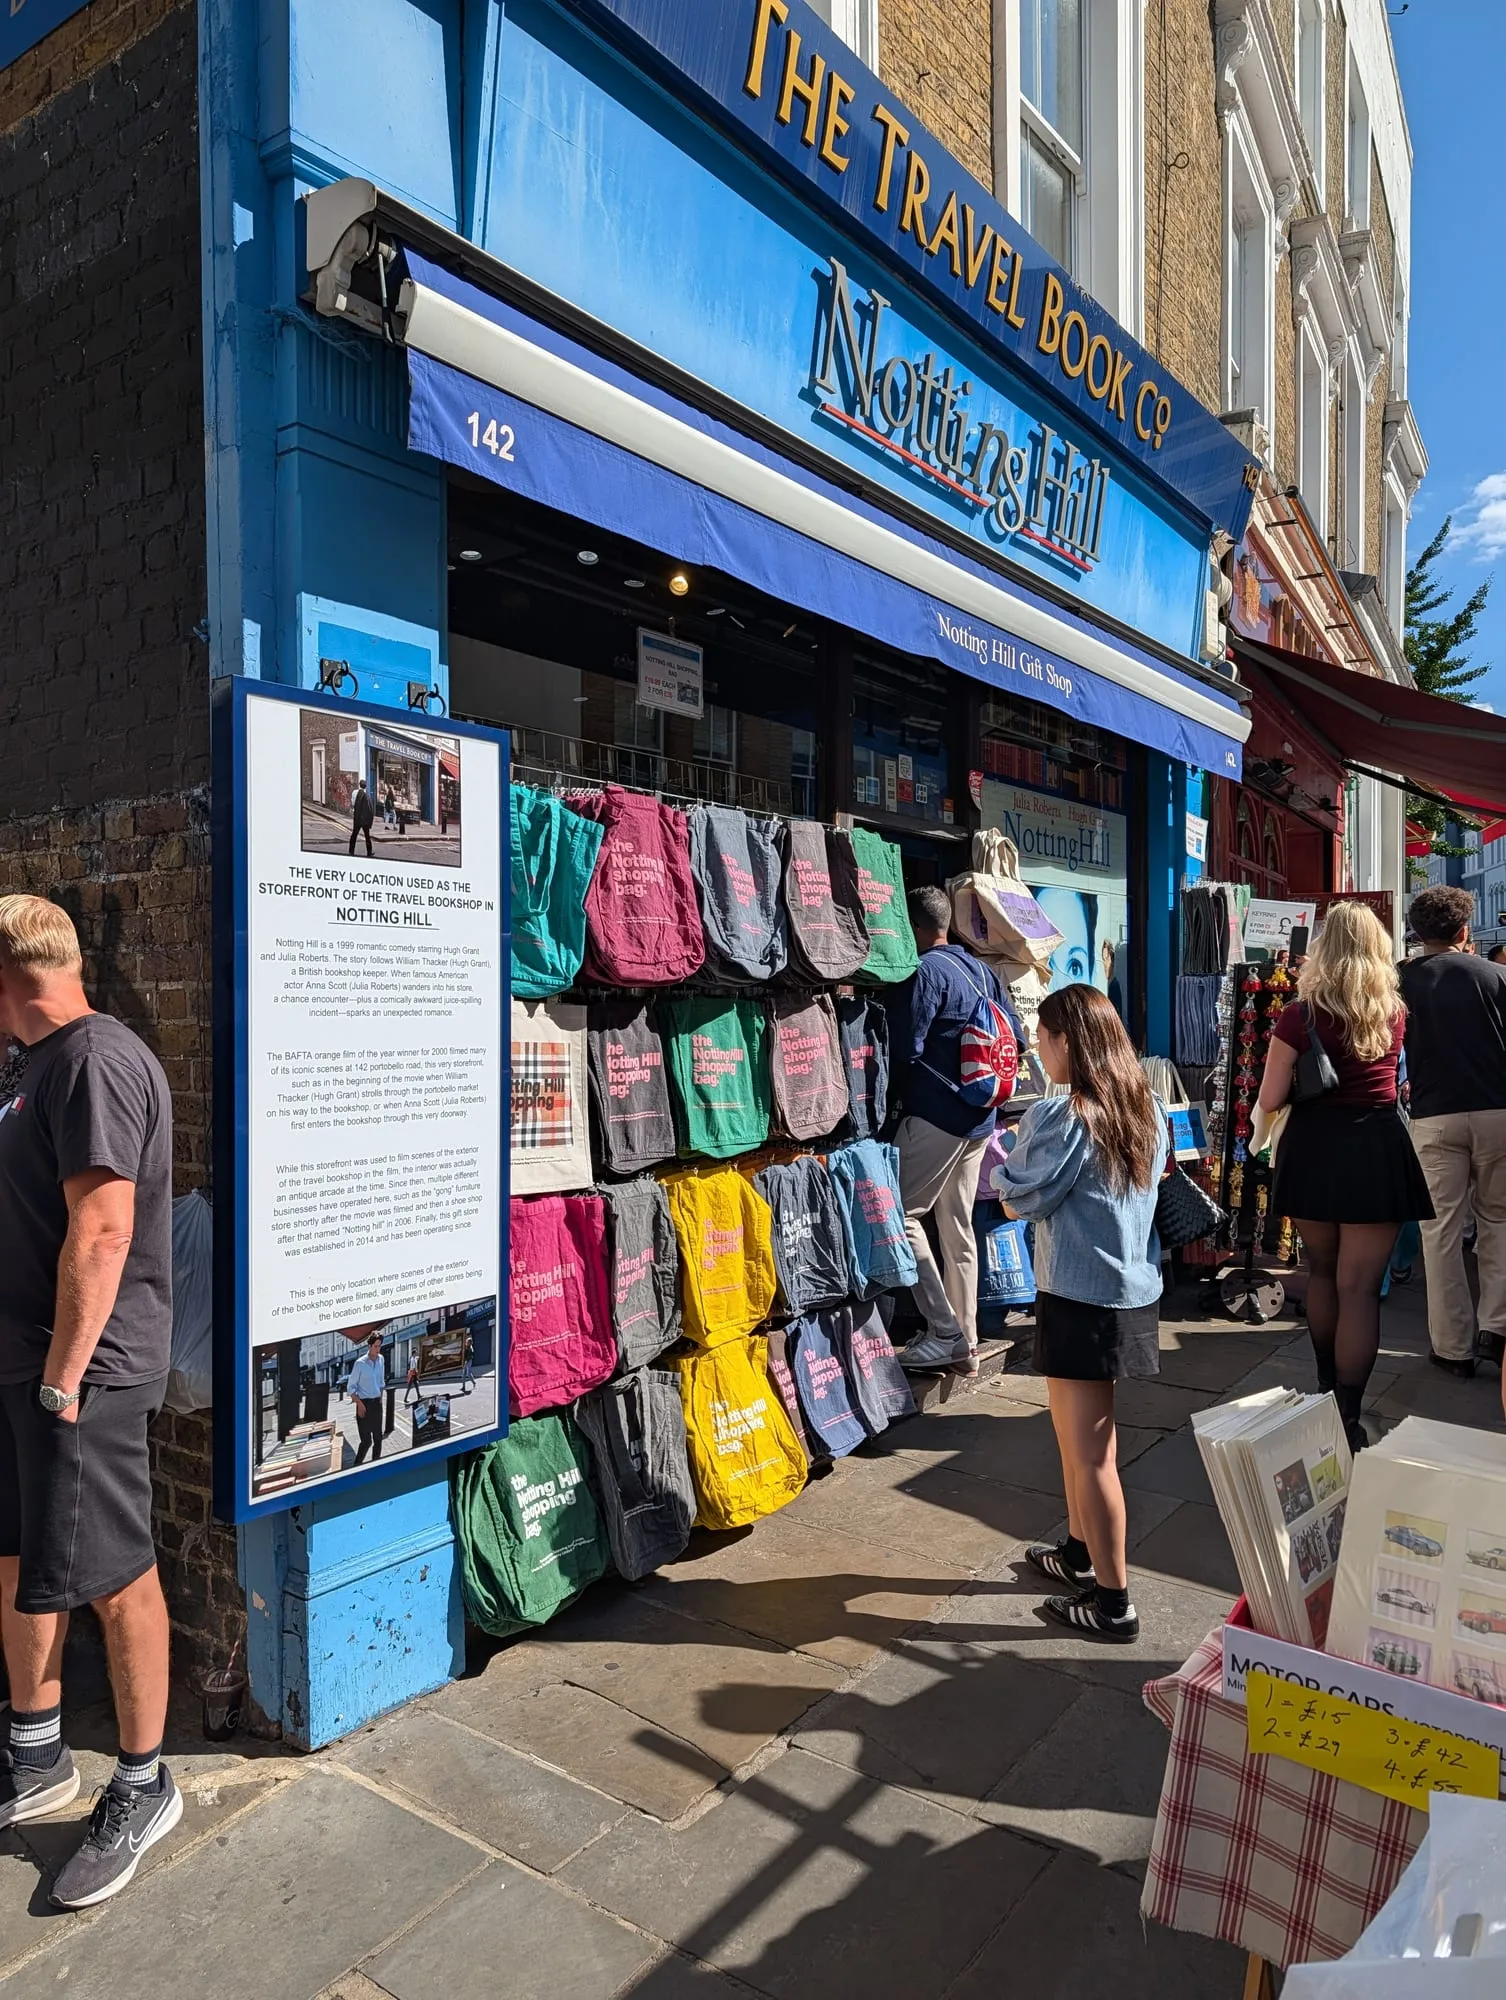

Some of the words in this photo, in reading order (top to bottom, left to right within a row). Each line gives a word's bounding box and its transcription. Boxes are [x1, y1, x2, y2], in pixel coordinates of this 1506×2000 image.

[746, 0, 855, 172] THE
[873, 104, 1025, 329] TRAVEL
[1037, 272, 1133, 421] BOOK
[468, 411, 514, 462] 142
[937, 612, 988, 665] Notting
[991, 638, 1016, 671] Hill
[1020, 653, 1043, 681] Gift
[1046, 664, 1072, 699] Shop
[374, 736, 386, 747] THE
[386, 740, 406, 754] TRAVEL
[1013, 792, 1030, 810] Julia
[289, 866, 312, 879] THE
[316, 868, 346, 882] VERY
[350, 872, 404, 887] LOCATION
[406, 877, 434, 890] USED
[436, 880, 450, 890] AS
[453, 882, 471, 893] THE
[258, 882, 339, 900] STOREFRONT
[342, 889, 358, 900] OF
[361, 890, 382, 902] THE
[386, 892, 425, 906] TRAVEL
[428, 896, 482, 910] BOOKSHOP
[484, 901, 494, 911] IN
[336, 907, 400, 924] NOTTING
[404, 911, 432, 926] HILL
[275, 938, 304, 949] Notting
[306, 939, 318, 947] Hill
[320, 939, 326, 948] is
[336, 940, 354, 949] 1999
[356, 943, 387, 951] romantic
[388, 944, 415, 953] comedy
[417, 945, 441, 954] starring
[443, 946, 460, 955] Hugh
[462, 946, 479, 954] Grant
[260, 951, 275, 960] and
[277, 952, 296, 961] Julia
[333, 953, 347, 962] The
[349, 955, 367, 965] story
[369, 955, 393, 964] follows
[395, 956, 420, 964] William
[422, 957, 448, 966] Thacker
[449, 958, 468, 968] (Hugh
[298, 966, 322, 975] British
[324, 967, 361, 978] bookshop
[390, 969, 410, 977] When
[412, 969, 436, 978] famous
[438, 971, 468, 979] American
[283, 981, 304, 989] actor
[305, 980, 326, 989] Anna
[327, 981, 347, 989] Scott
[348, 981, 368, 991] (Julia
[370, 981, 400, 992] Roberts)
[280, 994, 309, 1003] chance
[379, 995, 411, 1005] comically
[443, 996, 481, 1005] juice-spilling
[382, 1008, 422, 1017] unexpected
[692, 1034, 712, 1047] the
[780, 1027, 800, 1040] the
[642, 1052, 660, 1066] Hill
[693, 1047, 730, 1063] Notting
[609, 1068, 650, 1084] hopping
[785, 1062, 812, 1076] bag:
[544, 1077, 564, 1092] Hill
[609, 1084, 630, 1099] ag:
[514, 1271, 552, 1290] otting
